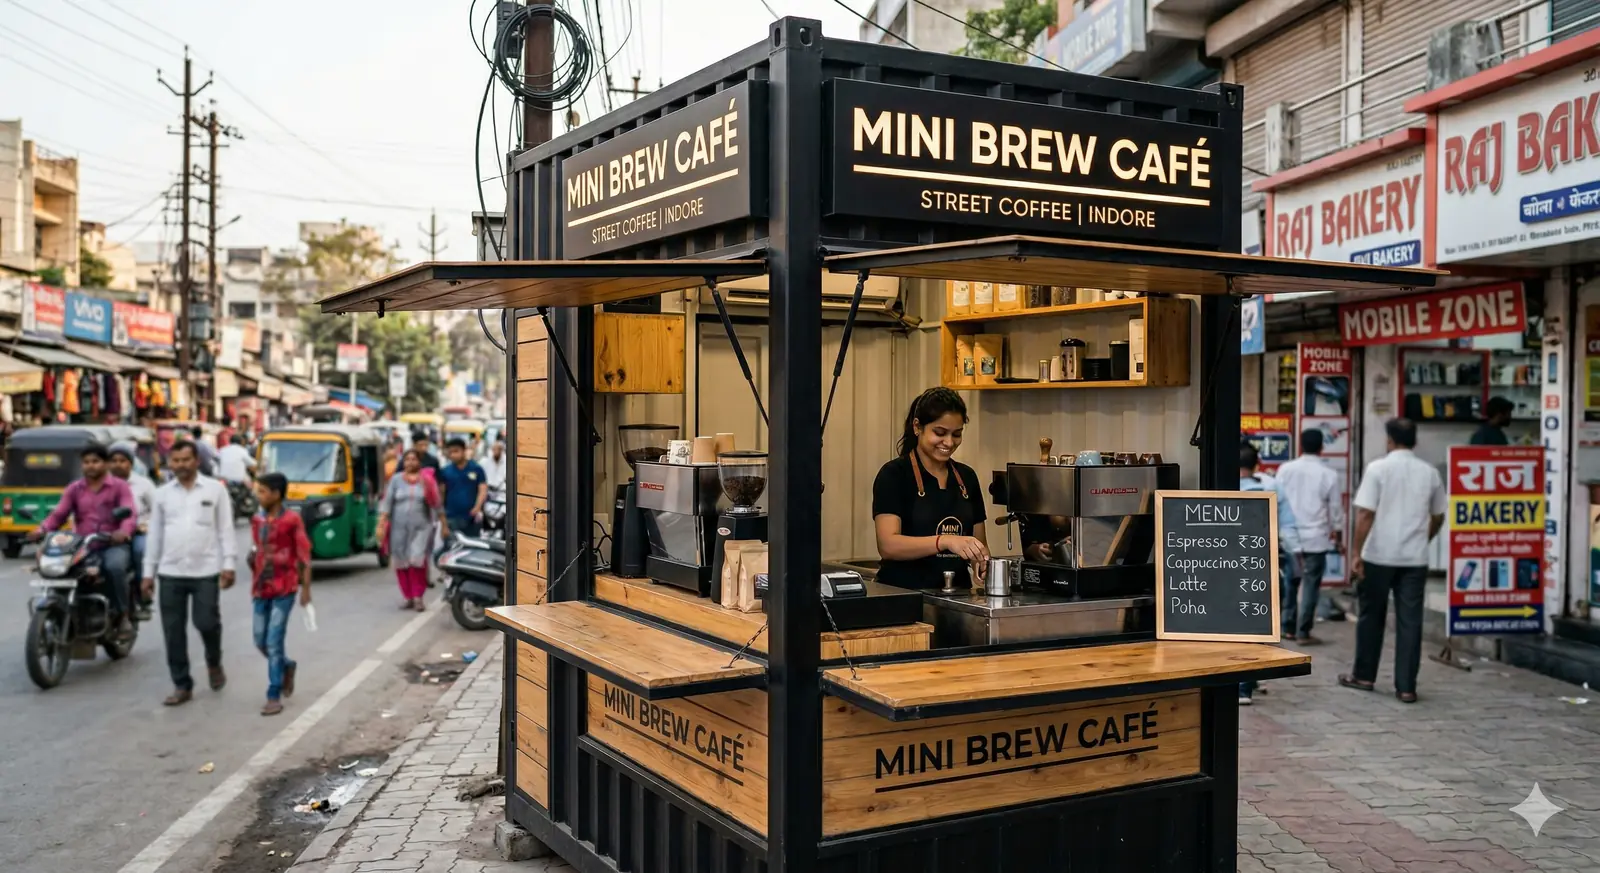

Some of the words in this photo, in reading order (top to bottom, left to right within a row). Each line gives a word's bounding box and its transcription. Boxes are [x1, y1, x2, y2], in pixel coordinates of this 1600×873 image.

[567, 165, 603, 211] MINI
[610, 139, 668, 197] BREW
[674, 97, 738, 173] CAFÉ
[853, 107, 955, 161] MINI
[971, 121, 1098, 175] BREW
[1108, 137, 1211, 189] CAFÉ
[1445, 120, 1505, 196] RAJ
[592, 222, 621, 244] STREET
[623, 211, 657, 235] COFFEE
[665, 197, 704, 224] INDORE
[921, 189, 992, 214] STREET
[999, 197, 1072, 221] COFFEE
[1089, 205, 1156, 228] INDORE
[1277, 204, 1313, 259] RAJ
[1321, 173, 1422, 247] BAKERY
[1372, 243, 1415, 266] BAKERY
[1344, 300, 1432, 341] MOBILE
[1439, 290, 1518, 333] ZONE
[1303, 347, 1349, 360] MOBILE
[1310, 361, 1343, 373] ZONE
[1457, 460, 1538, 491] राज
[1185, 504, 1240, 522] MENU
[1456, 501, 1540, 525] BAKERY
[942, 524, 959, 532] MINI
[1167, 531, 1228, 552] Espresso
[1239, 534, 1266, 549] ₹30
[1166, 553, 1239, 573] Cappuccino
[1239, 556, 1266, 570] ₹50
[1169, 575, 1207, 591] Latte
[1240, 578, 1267, 593] ₹60
[1171, 596, 1207, 614] Poha
[1239, 601, 1268, 617] ₹30
[604, 683, 635, 721] MINI
[640, 698, 690, 745] BREW
[694, 733, 744, 773] CAFÉ
[875, 739, 953, 779] MINI
[966, 722, 1068, 766] BREW
[1077, 702, 1159, 749] CAFÉ
